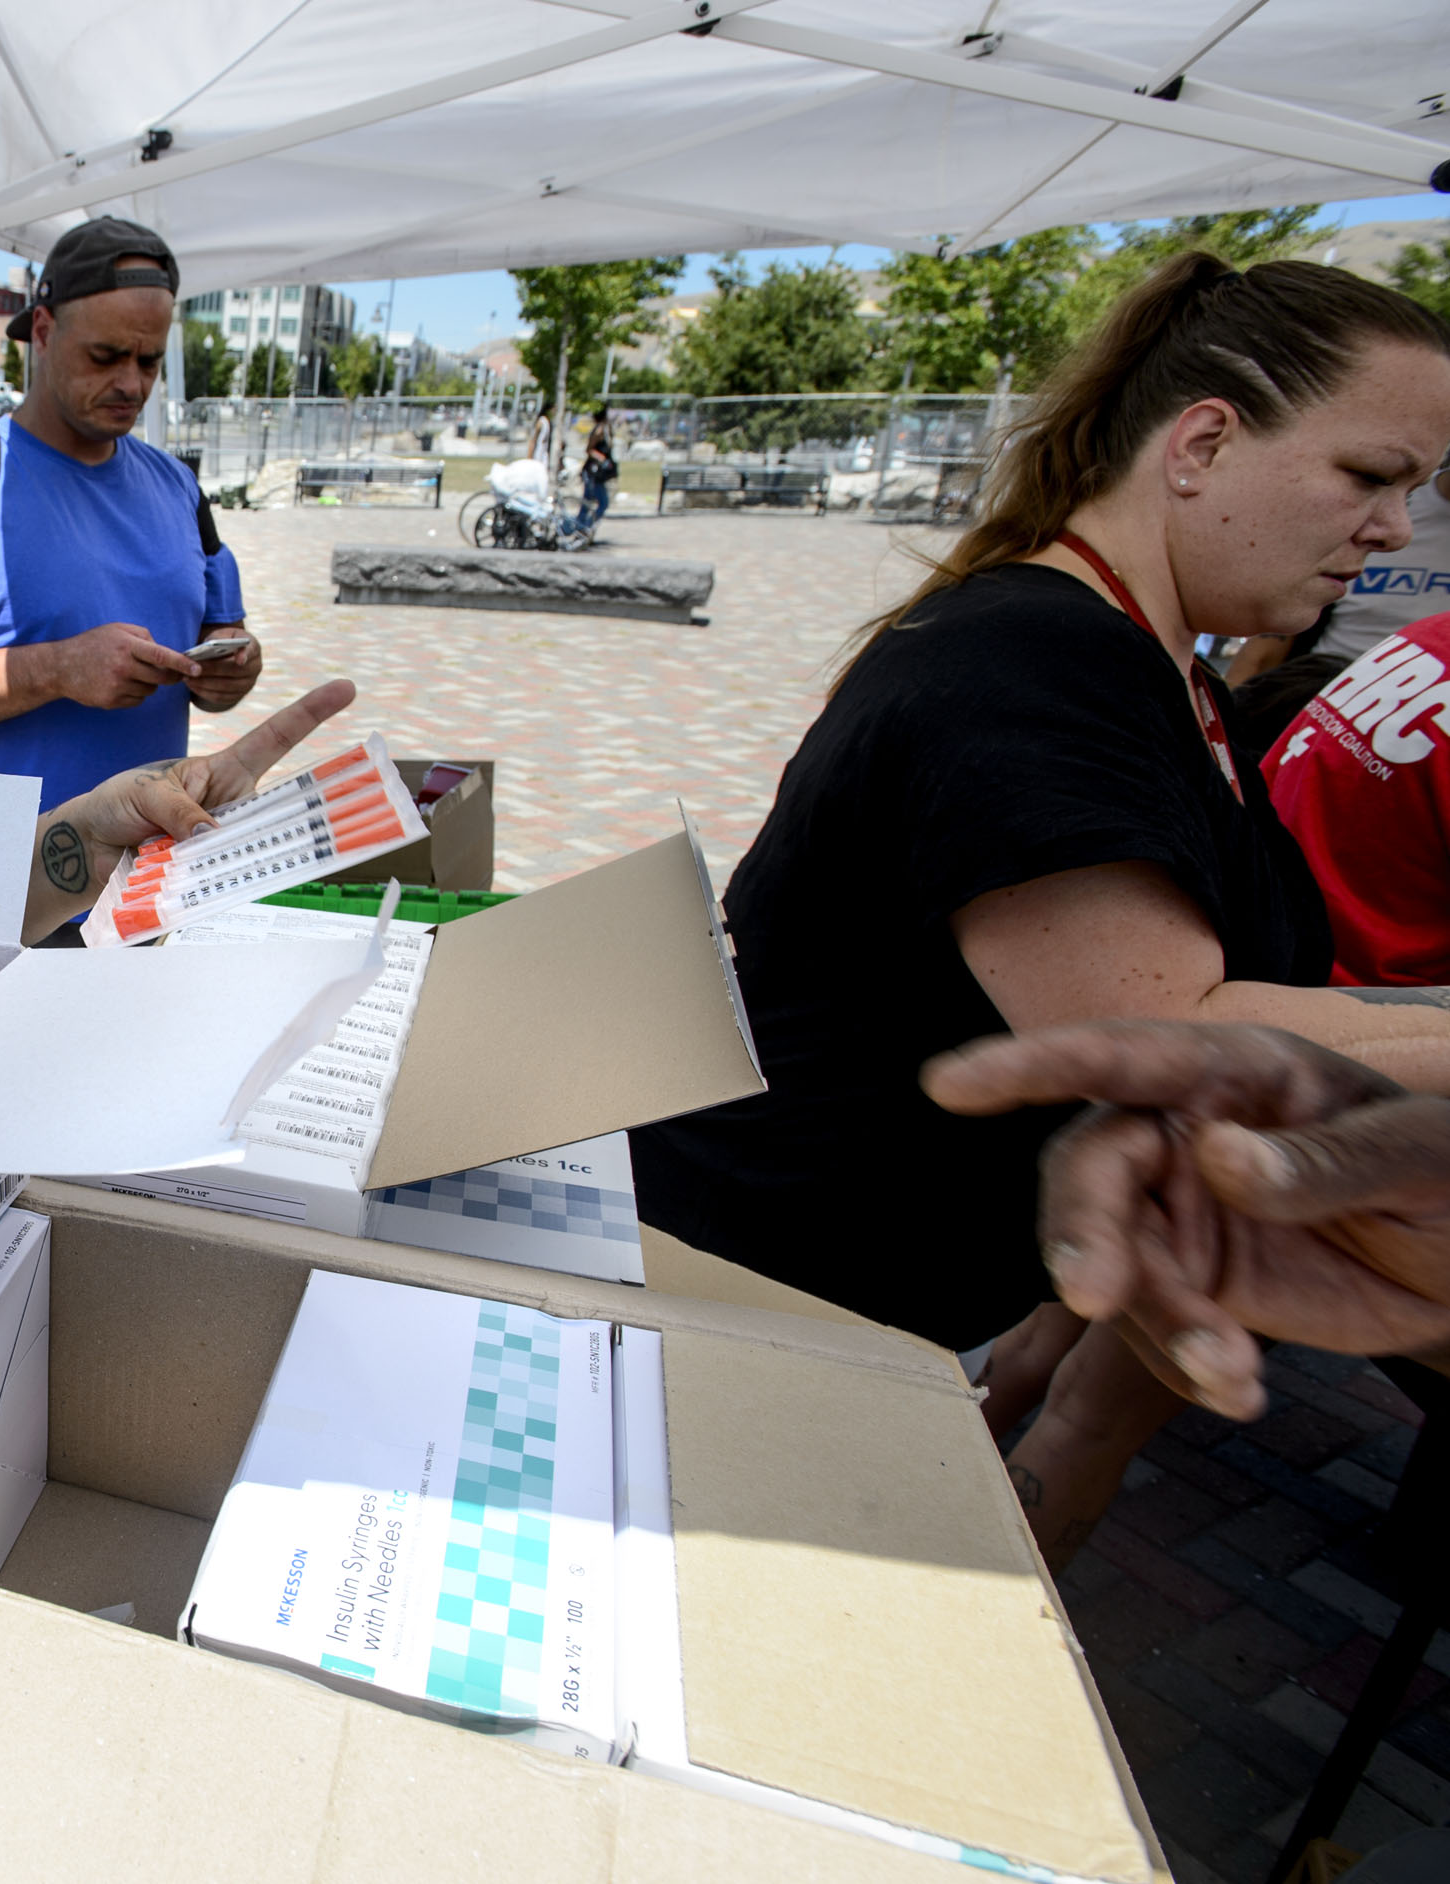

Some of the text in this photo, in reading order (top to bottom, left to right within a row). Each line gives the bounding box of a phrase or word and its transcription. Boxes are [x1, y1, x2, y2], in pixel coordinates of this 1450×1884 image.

[1338, 728, 1394, 782] COALITION
[200, 886, 211, 897] 90
[214, 881, 225, 893] 80
[229, 877, 239, 887] 70
[187, 890, 199, 907] 100
[557, 1160, 592, 1175] 1cc
[176, 1186, 190, 1195] 27G
[386, 1489, 409, 1512] 1cc
[325, 1493, 379, 1643] Insulin Syringes
[366, 1519, 403, 1604] Needles
[276, 1548, 309, 1627] McKESSON
[566, 1600, 584, 1624] 100
[363, 1606, 386, 1651] with
[568, 1664, 581, 1675] x
[561, 1679, 580, 1713] 28G
